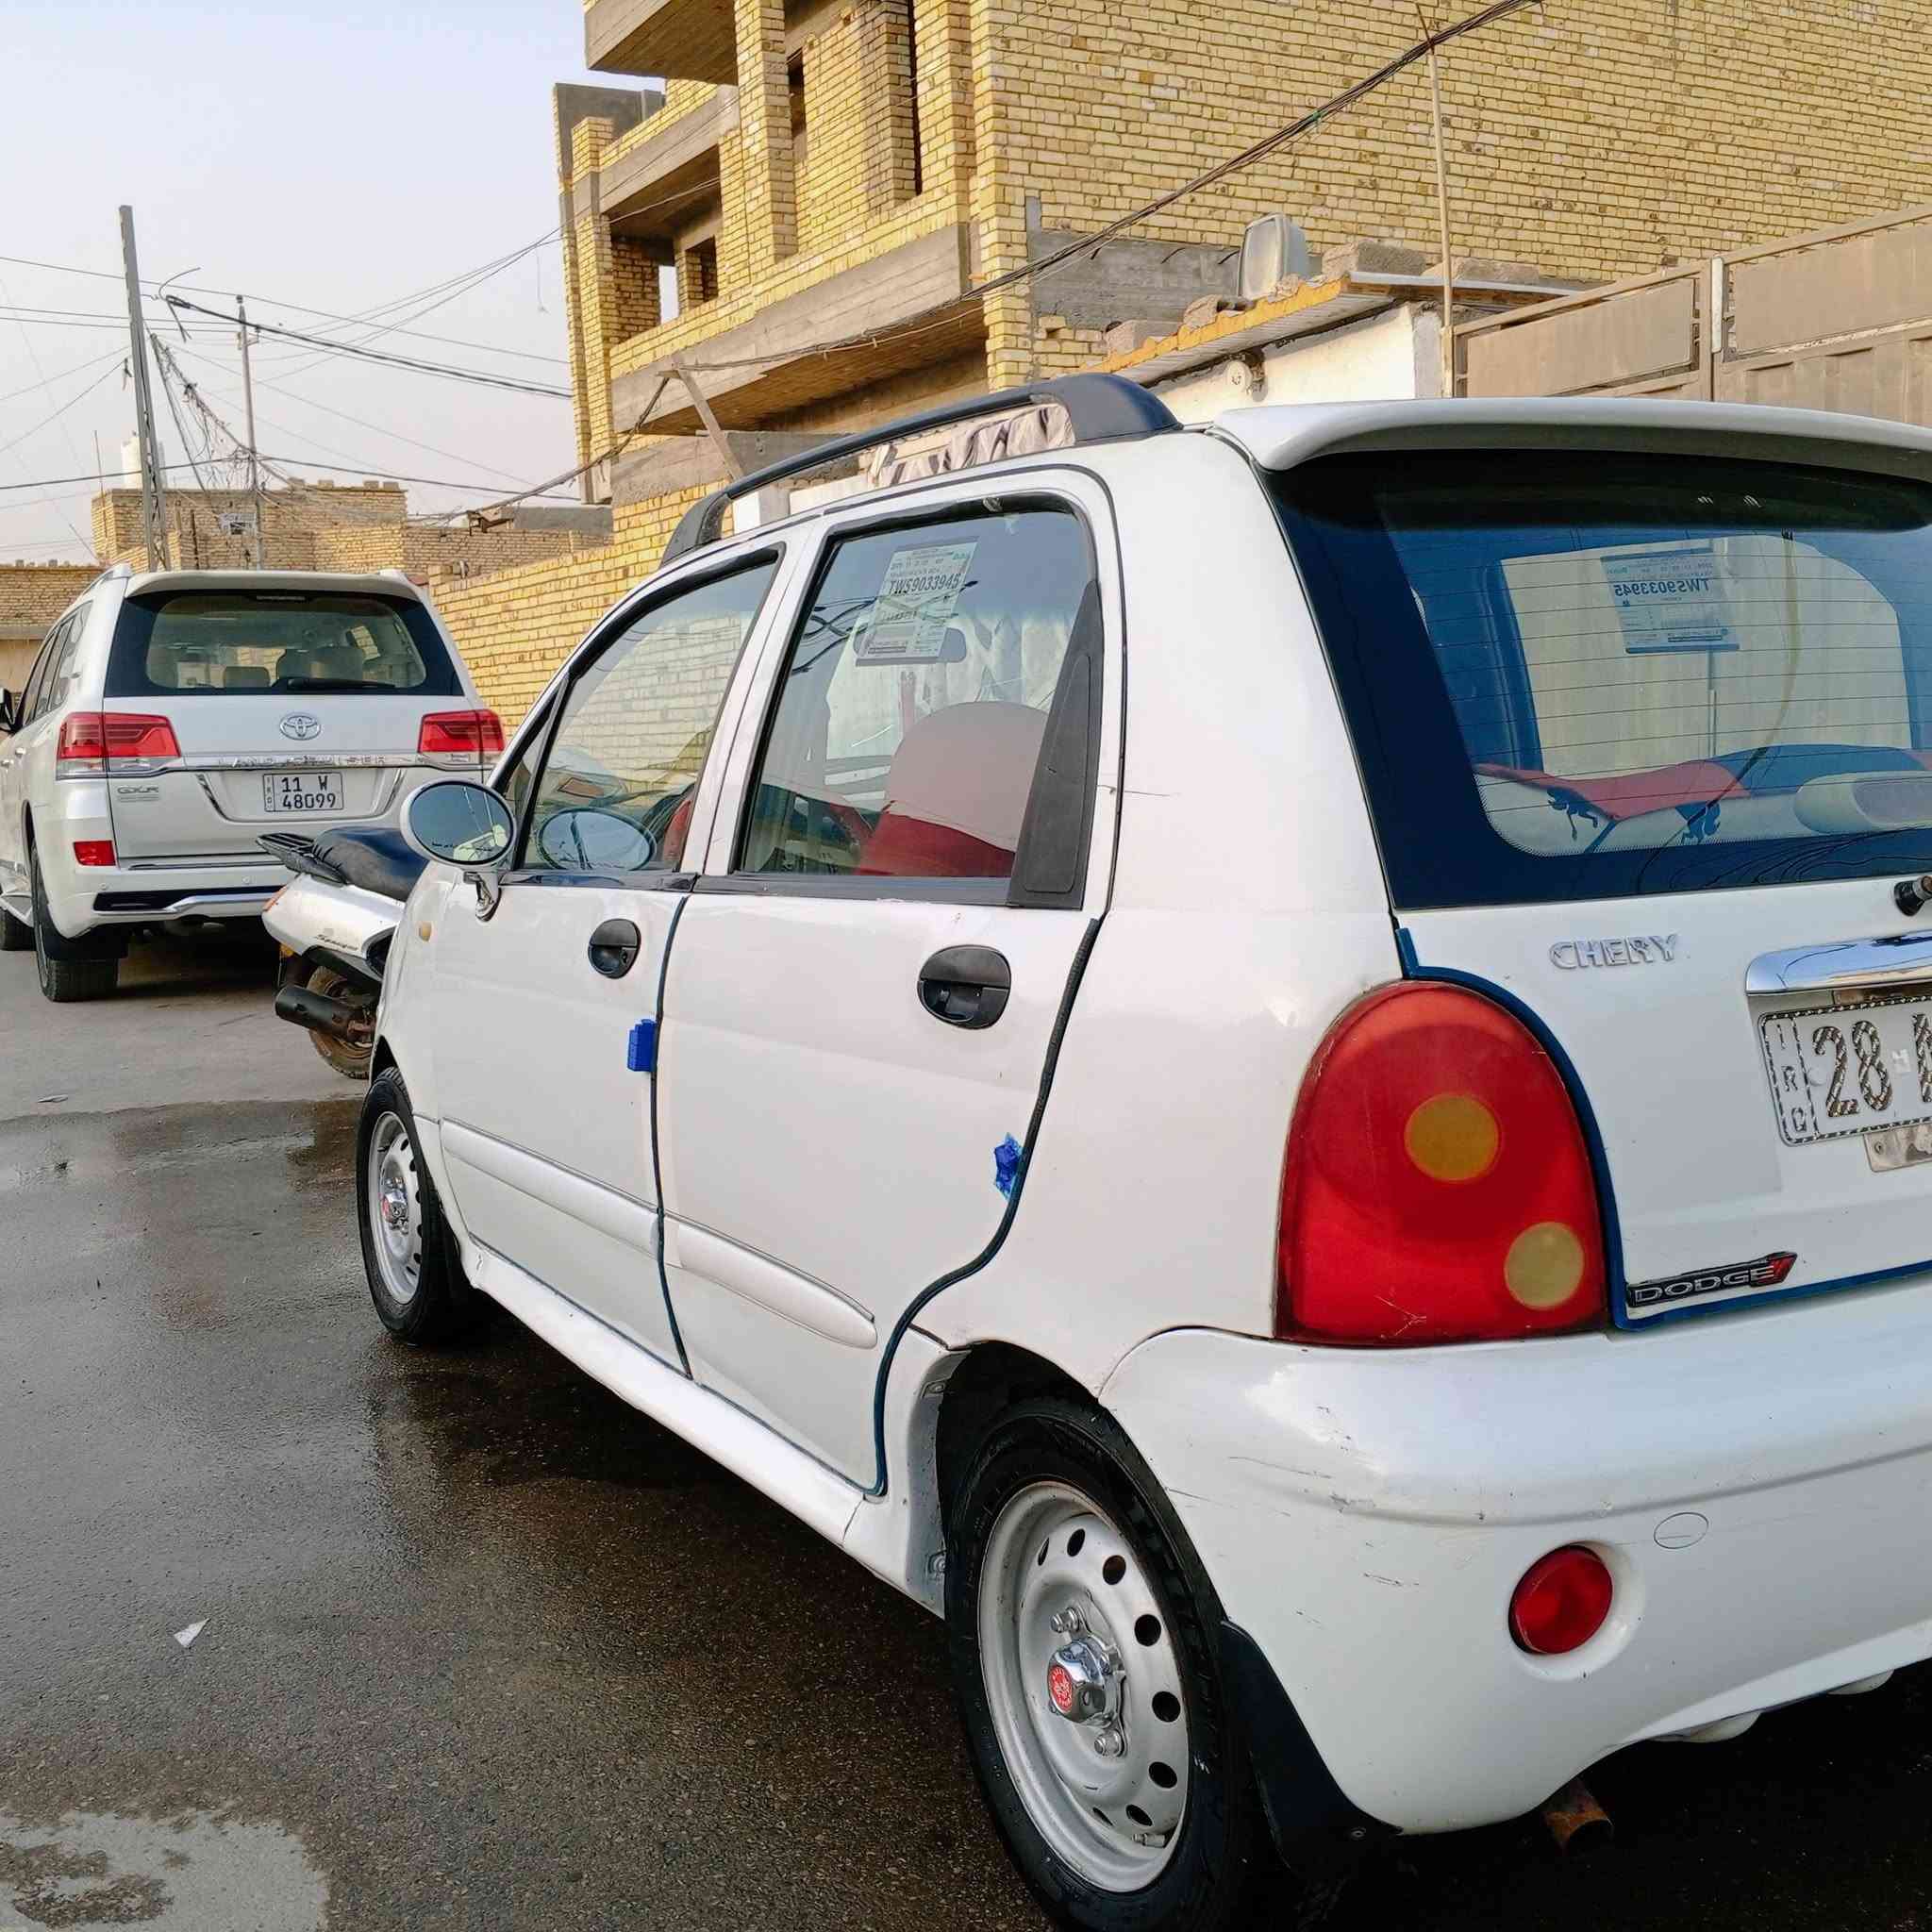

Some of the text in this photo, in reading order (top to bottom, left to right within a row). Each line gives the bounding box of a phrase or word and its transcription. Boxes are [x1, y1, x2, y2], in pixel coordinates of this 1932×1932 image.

[281, 774, 328, 792] 11 W
[283, 792, 336, 809] 48099
[1549, 934, 1677, 970] CHERY
[1812, 1019, 1892, 1118] 28
[1634, 1264, 1774, 1303] DODGE
